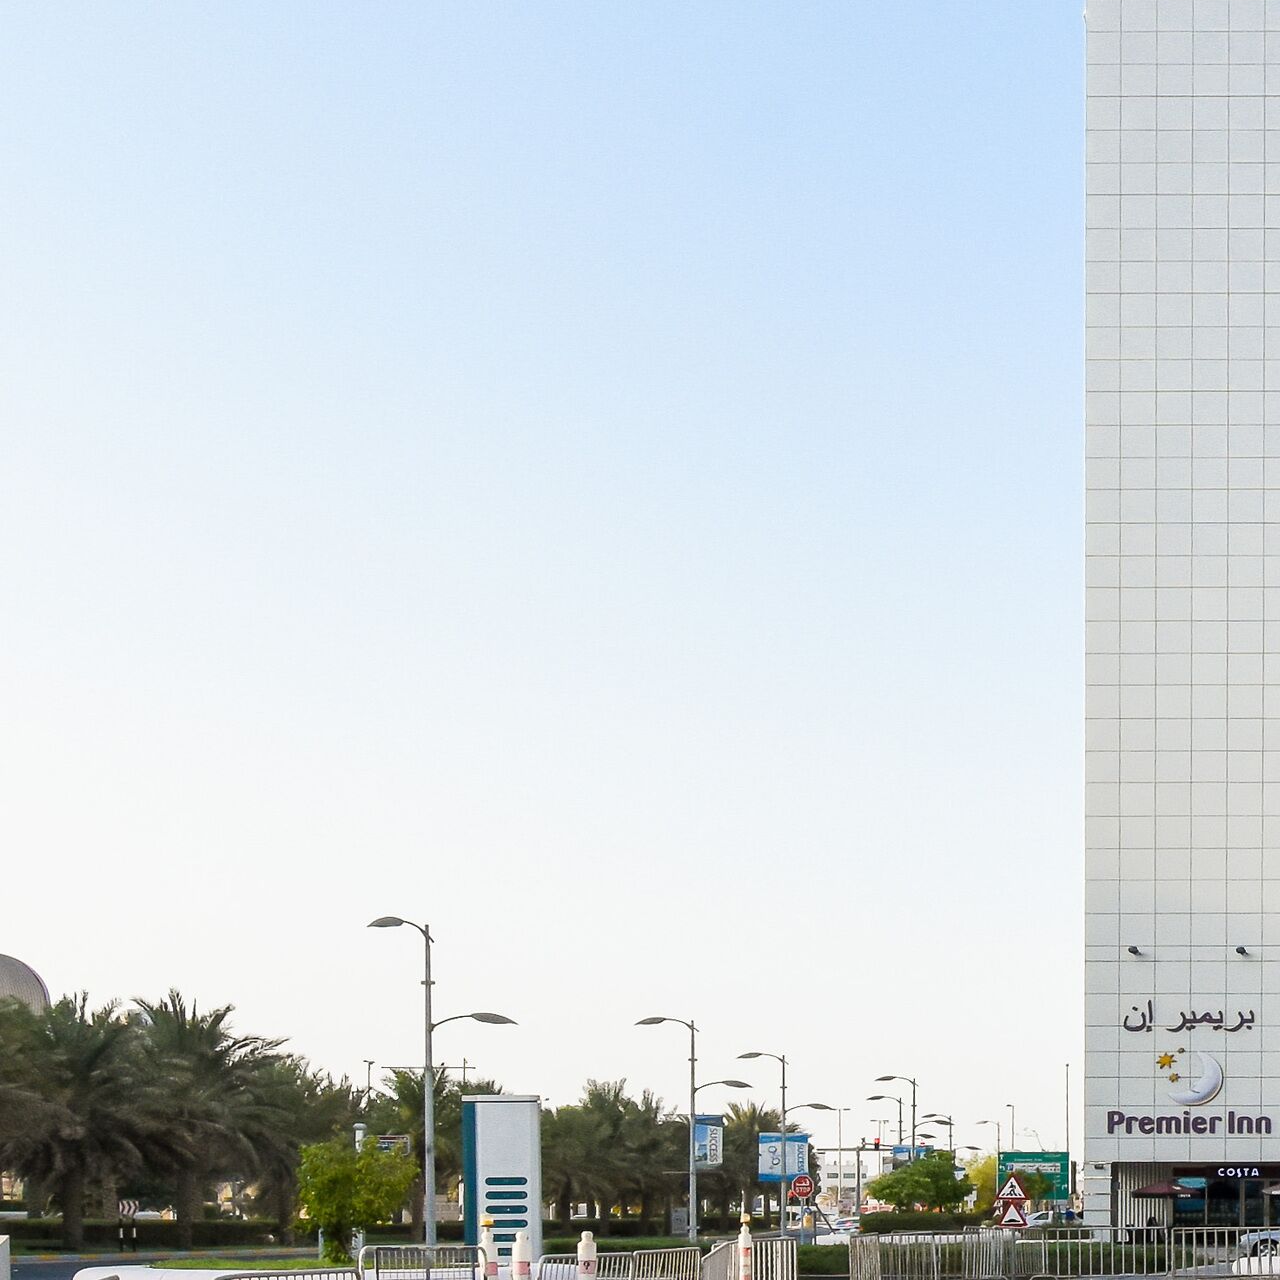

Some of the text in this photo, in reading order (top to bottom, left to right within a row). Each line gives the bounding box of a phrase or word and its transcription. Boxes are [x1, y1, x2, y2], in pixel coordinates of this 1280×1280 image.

[1123, 999, 1255, 1033] بريمير إن
[1106, 1110, 1273, 1135] Premier Inn
[709, 1127, 719, 1163] SUCCESS
[1217, 1167, 1260, 1178] COSTA
